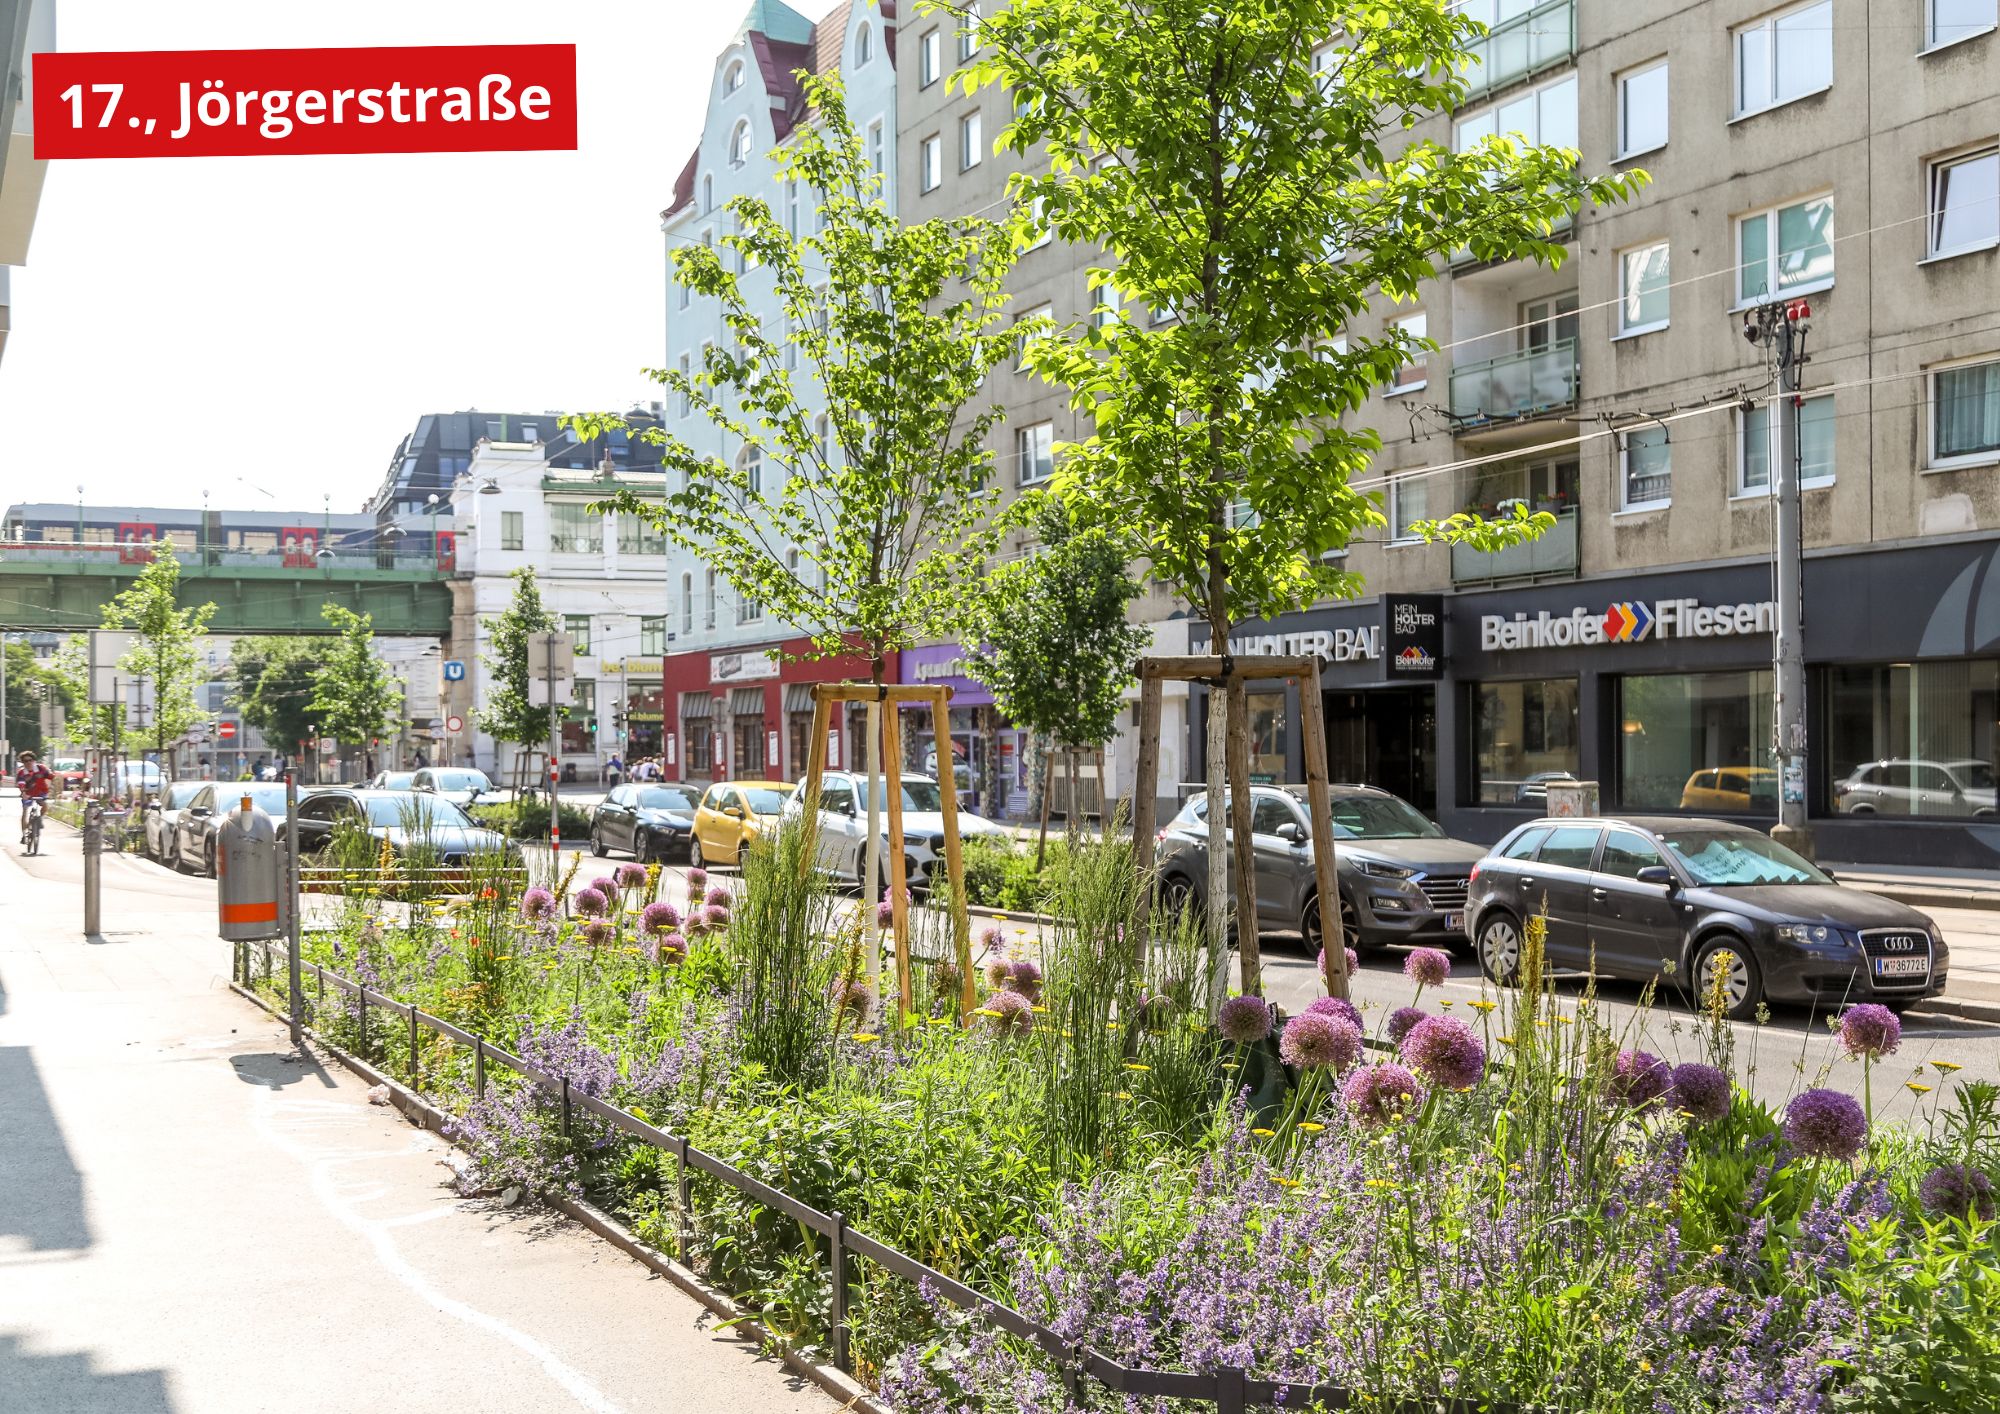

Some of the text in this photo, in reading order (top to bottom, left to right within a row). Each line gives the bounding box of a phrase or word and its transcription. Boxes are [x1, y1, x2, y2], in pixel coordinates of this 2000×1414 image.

[1394, 604, 1418, 614] MEIN
[1394, 614, 1435, 625] HOLTER
[1395, 624, 1416, 634] BAD
[1481, 598, 1776, 652] Beinkofer Fliesen
[1395, 655, 1436, 665] Beinkofer
[449, 664, 462, 678] U
